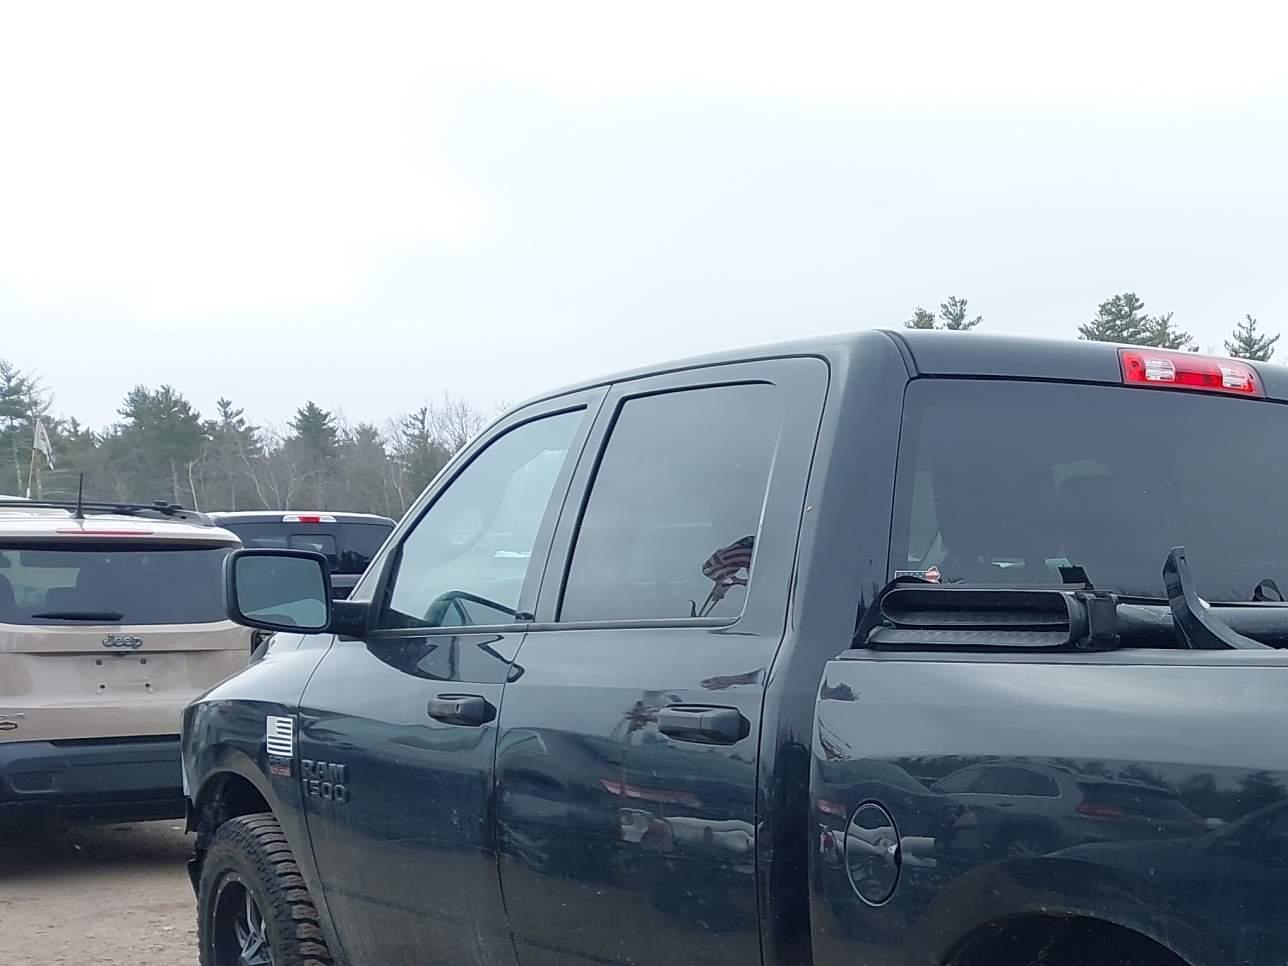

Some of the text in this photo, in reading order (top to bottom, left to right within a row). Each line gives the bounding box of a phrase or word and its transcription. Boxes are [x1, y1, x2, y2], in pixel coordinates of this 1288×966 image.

[102, 634, 143, 650] Jeep
[301, 759, 345, 784] RAM
[302, 779, 347, 802] 1500
